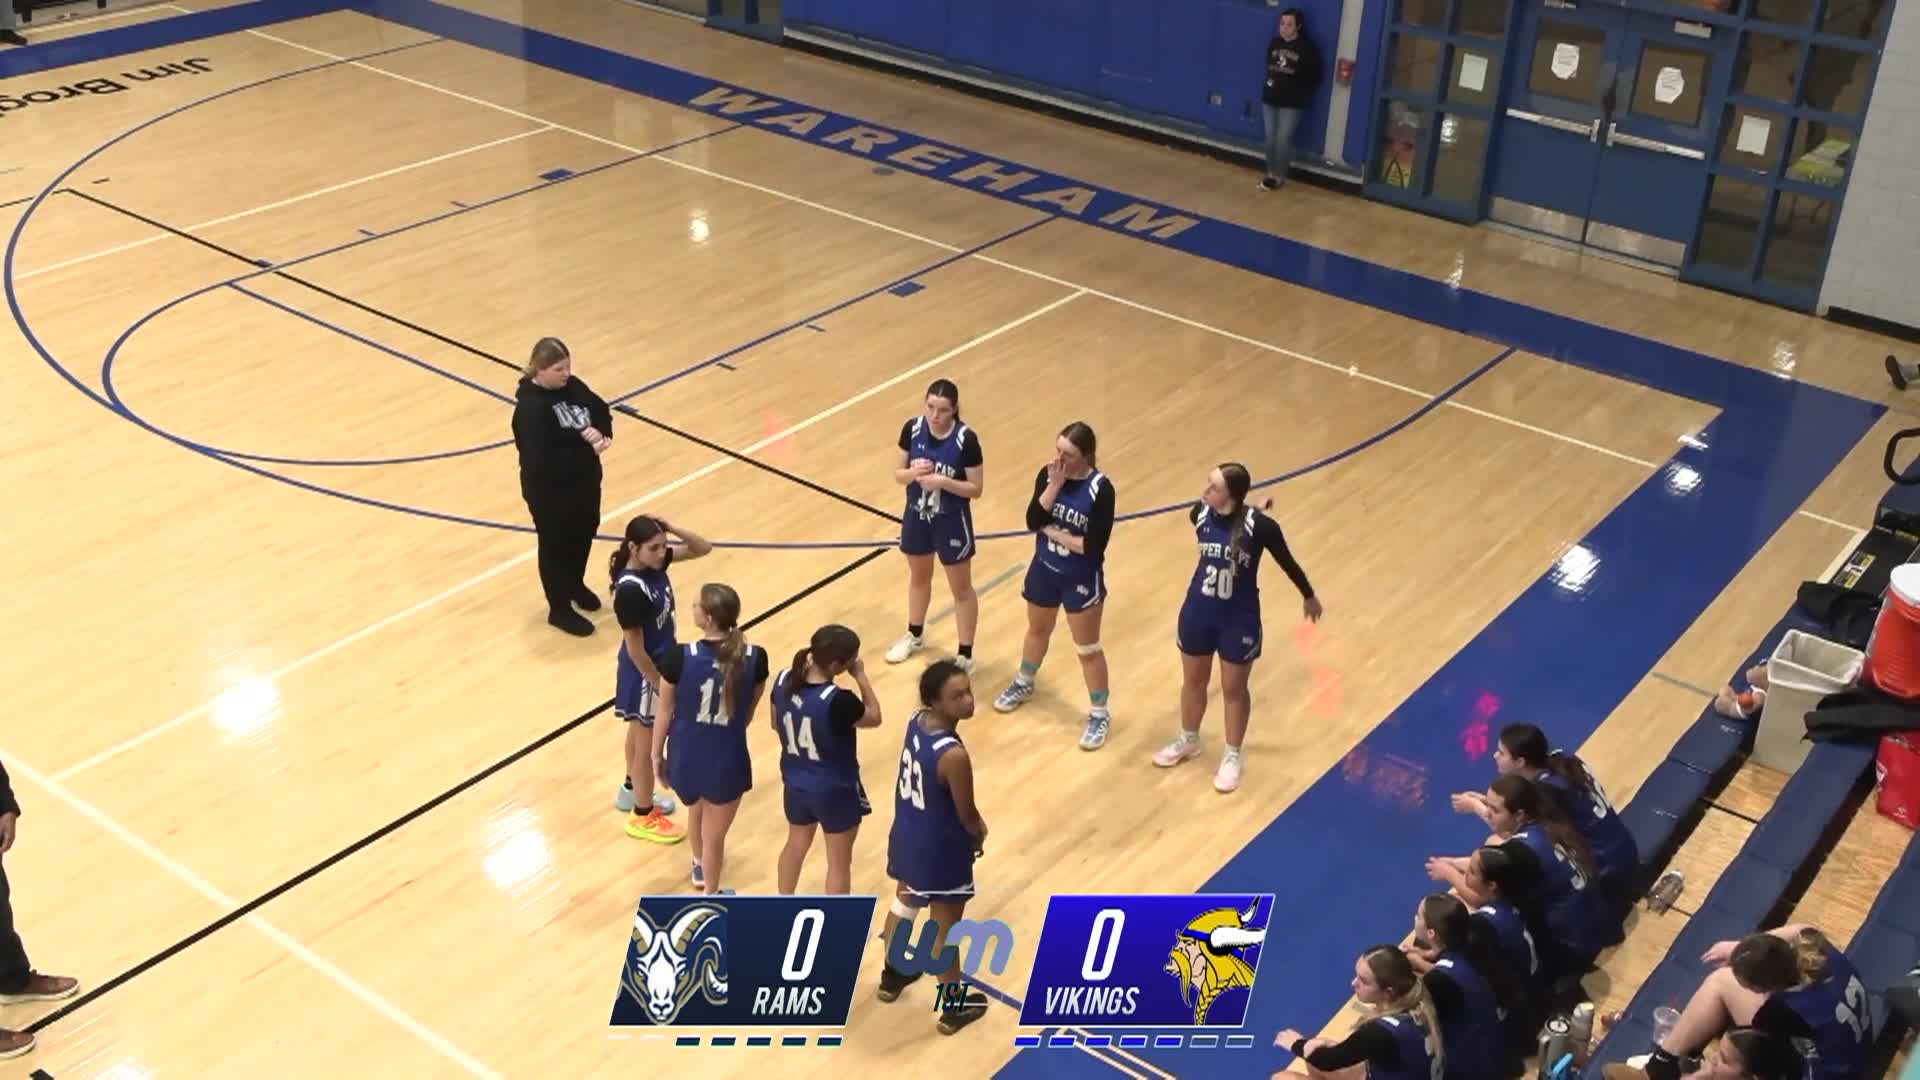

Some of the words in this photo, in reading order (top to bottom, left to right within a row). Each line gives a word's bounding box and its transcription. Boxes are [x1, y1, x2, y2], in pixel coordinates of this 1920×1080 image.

[121, 57, 213, 82] Jim
[688, 86, 1201, 239] WAREHAM
[1201, 564, 1233, 600] 20
[783, 711, 820, 762] 14
[899, 748, 925, 811] 33
